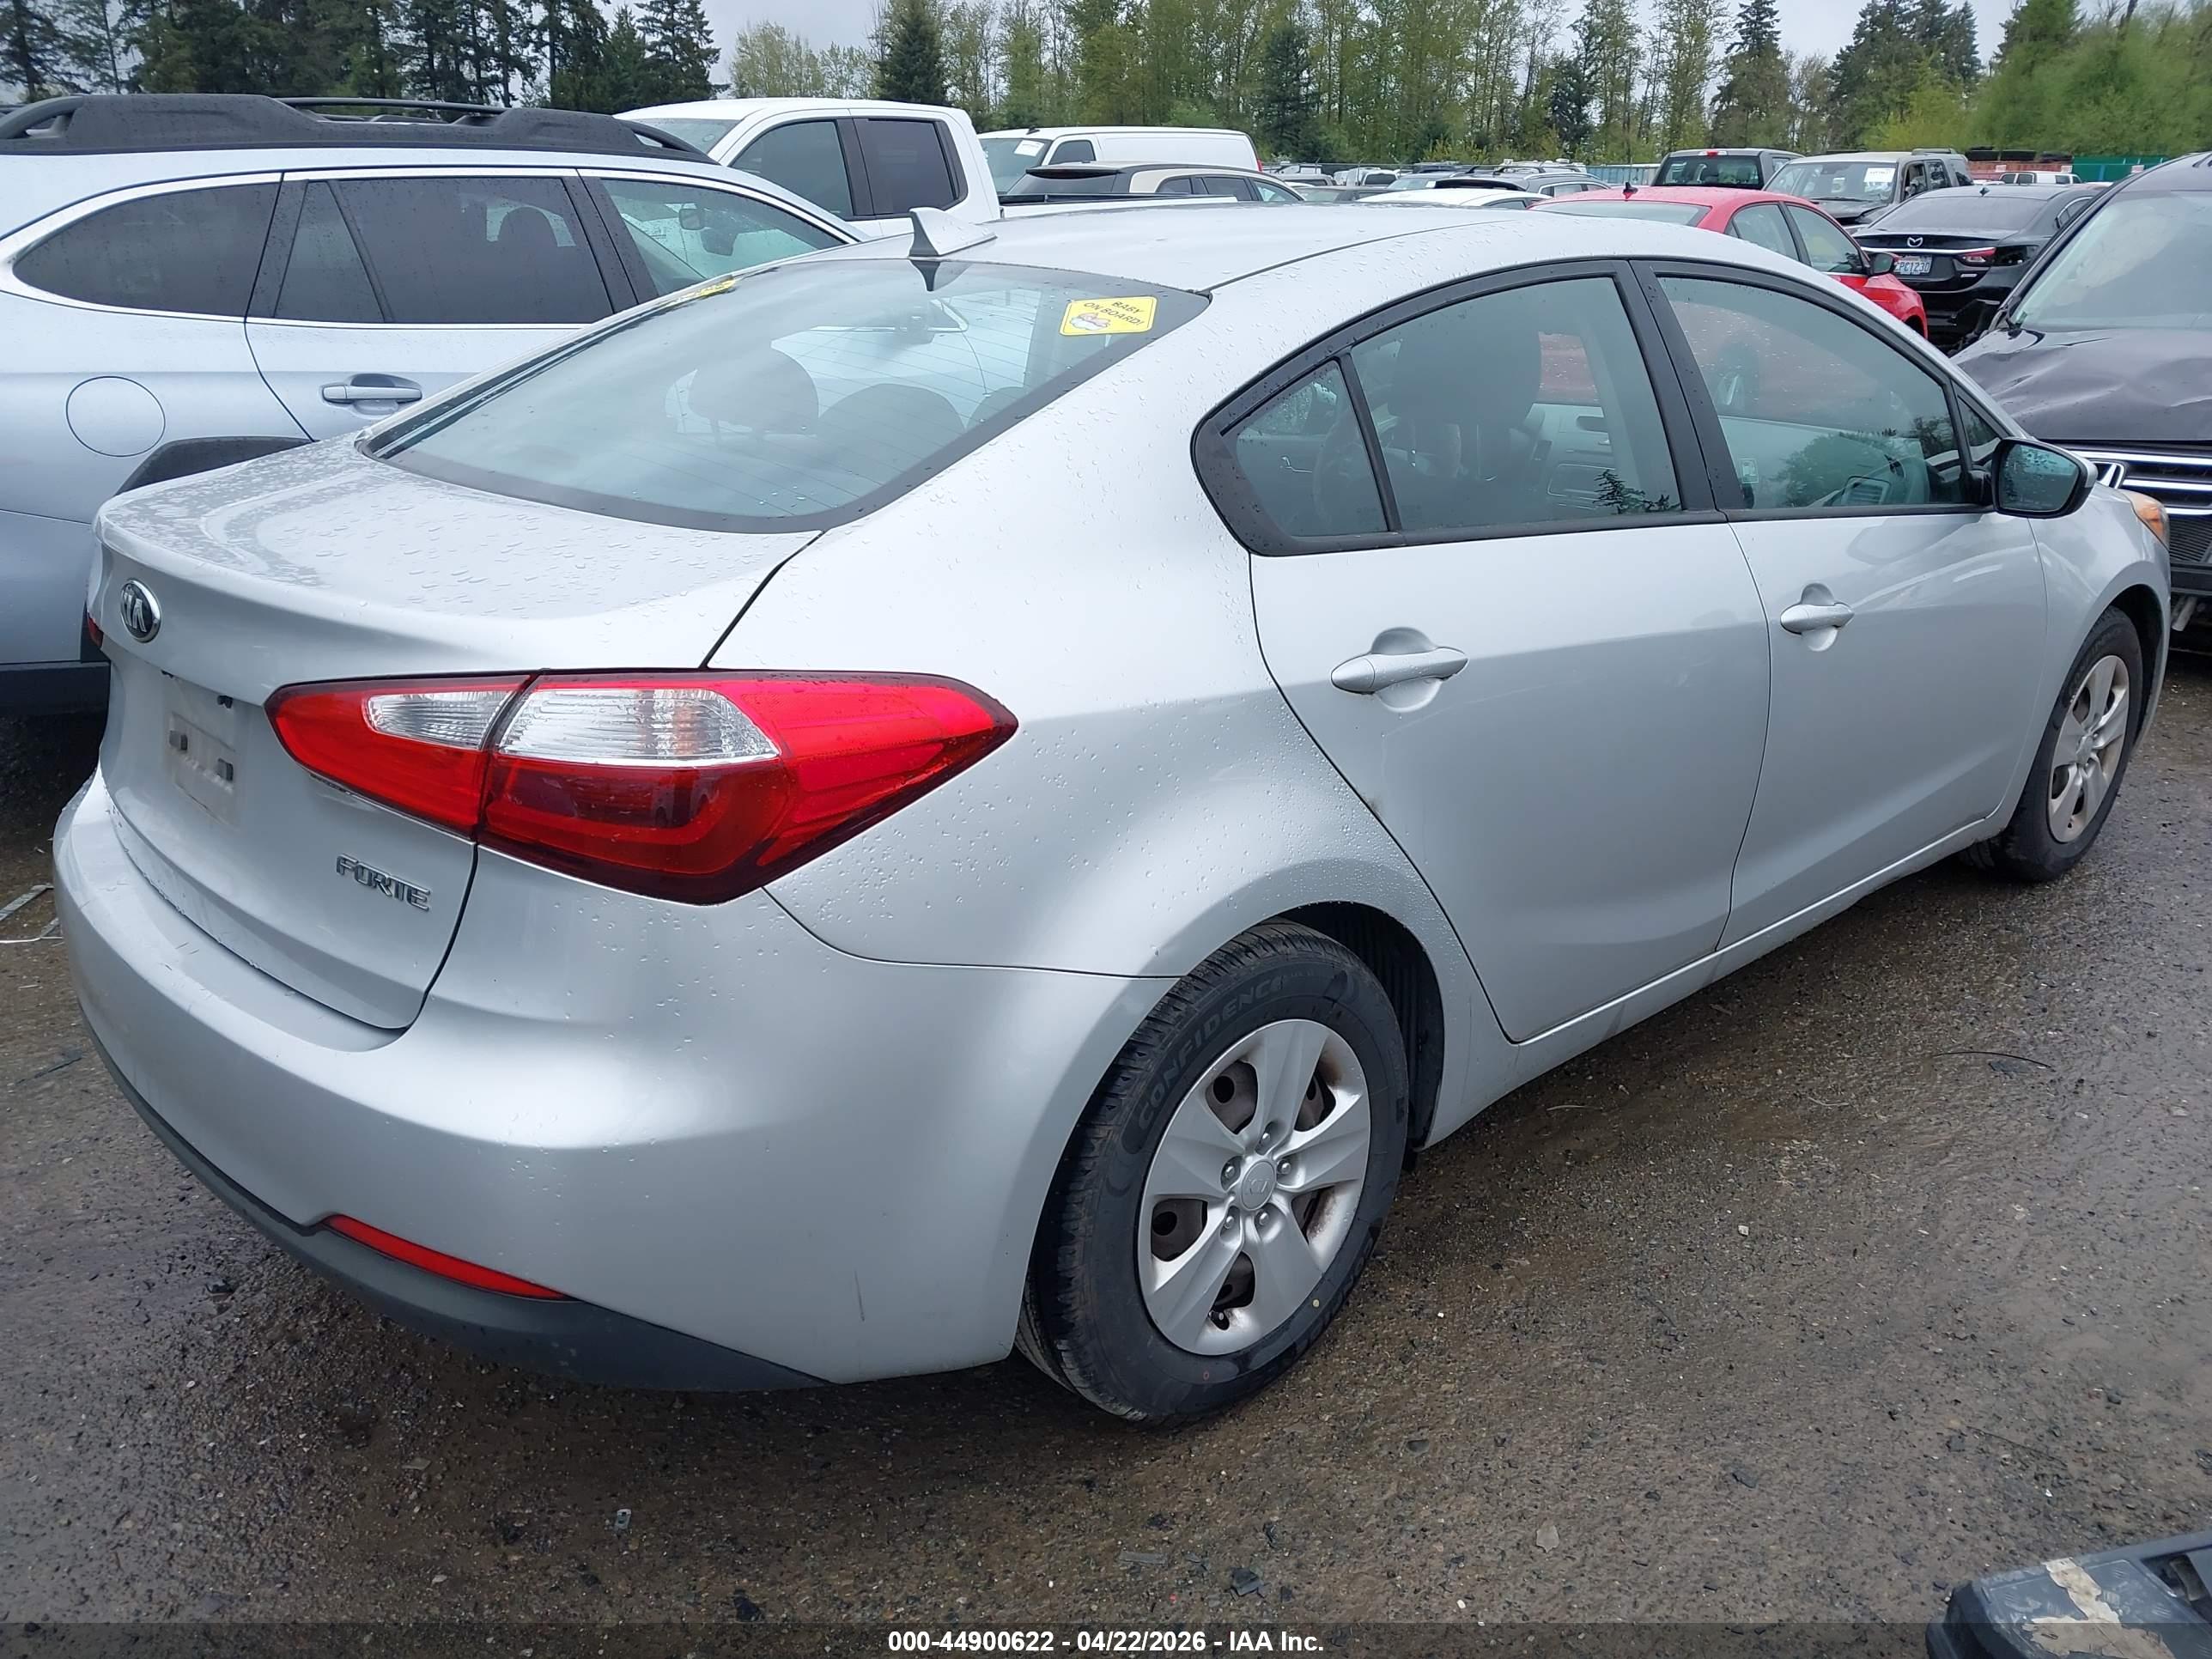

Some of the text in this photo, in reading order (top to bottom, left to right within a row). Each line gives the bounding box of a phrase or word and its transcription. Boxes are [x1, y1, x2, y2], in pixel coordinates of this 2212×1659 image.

[1100, 307, 1145, 325] BOARD!
[1111, 301, 1144, 313] BABY
[336, 853, 431, 912] FORTE
